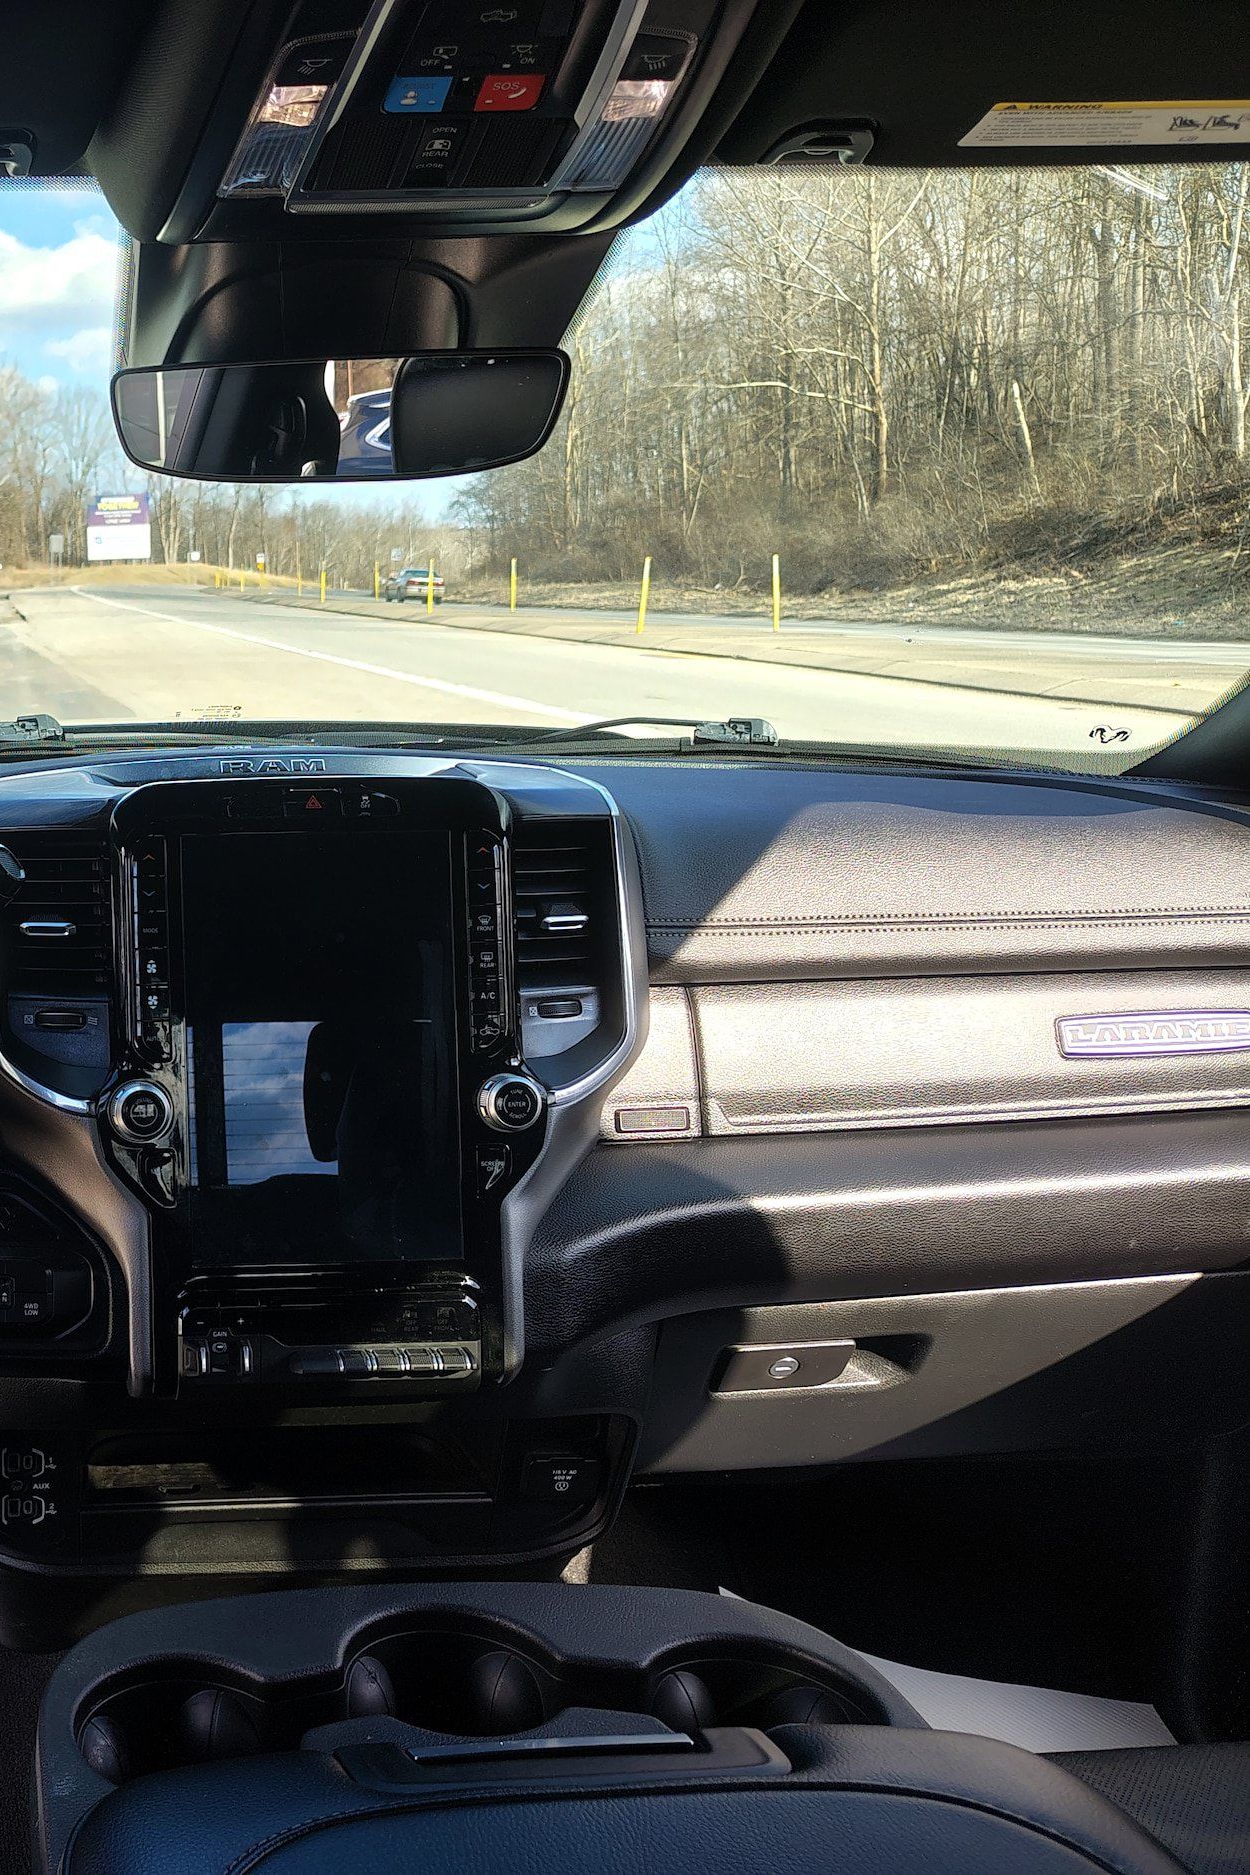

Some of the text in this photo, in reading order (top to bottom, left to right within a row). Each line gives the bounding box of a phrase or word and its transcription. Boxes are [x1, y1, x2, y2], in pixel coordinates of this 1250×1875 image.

[420, 59, 441, 67] OFF
[519, 57, 536, 65] ON
[492, 82, 521, 91] SOS
[220, 758, 327, 774] RAM
[480, 992, 496, 1000] A/C
[1065, 1020, 1250, 1046] LARAMIE
[32, 1482, 51, 1490] AUX
